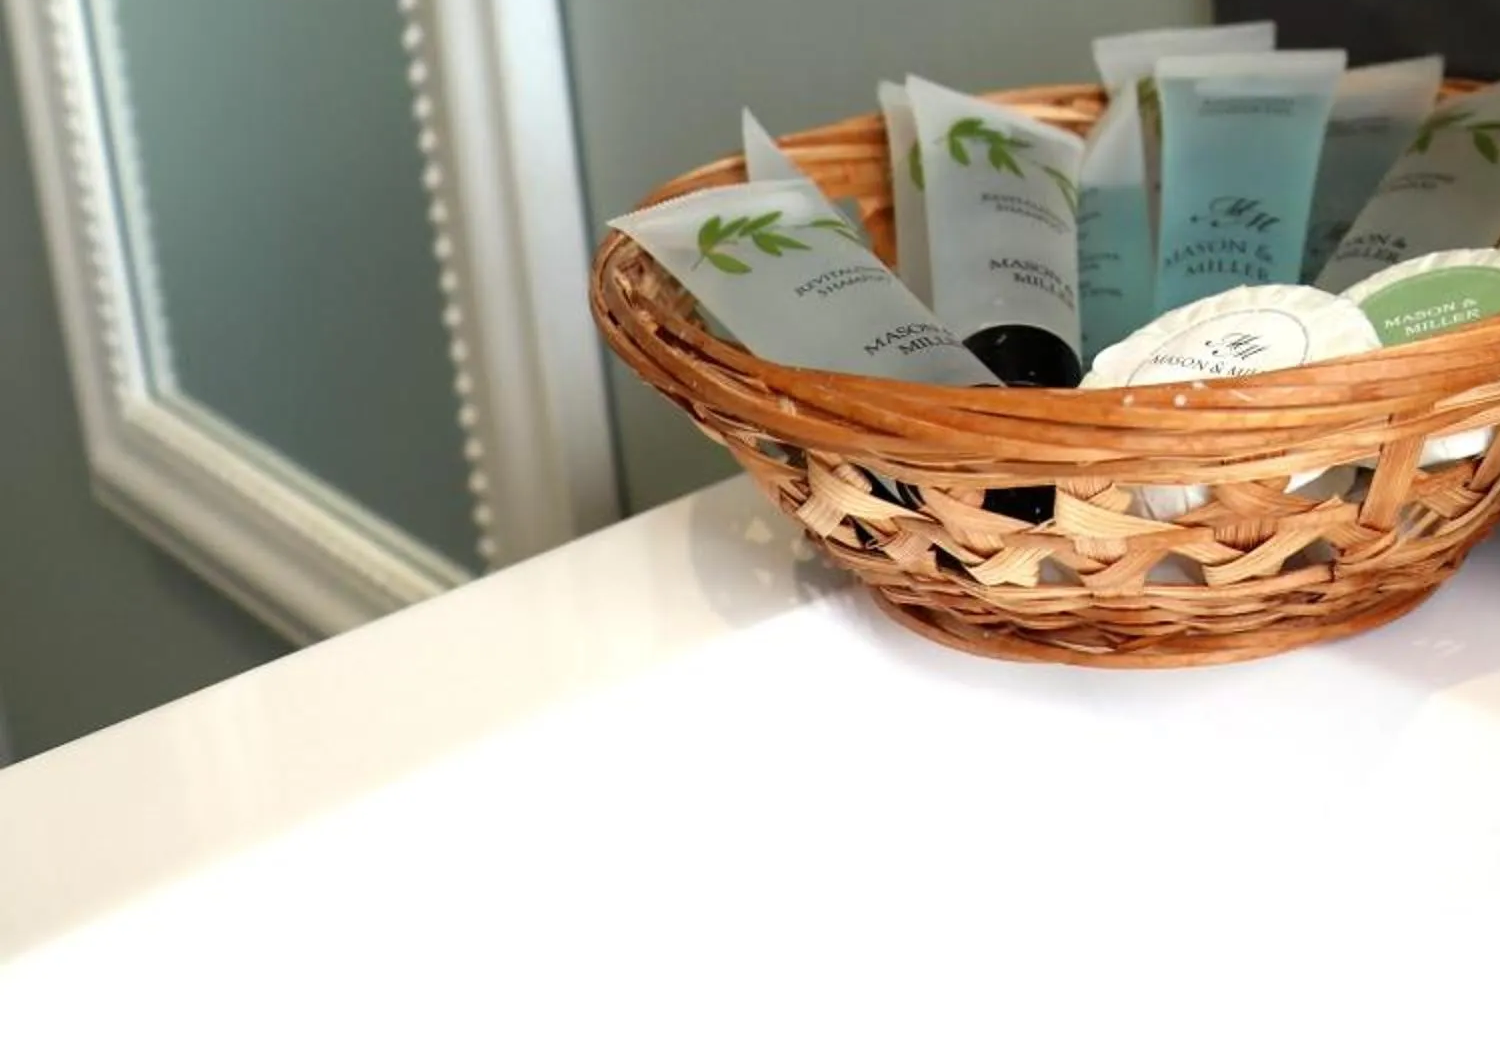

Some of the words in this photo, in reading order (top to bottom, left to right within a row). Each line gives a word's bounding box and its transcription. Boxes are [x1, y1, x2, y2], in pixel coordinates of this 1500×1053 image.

[1013, 272, 1076, 310] MILL
[1384, 300, 1456, 329] MASON
[1404, 307, 1481, 338] MILLER
[898, 335, 962, 356] MILL
[1151, 354, 1209, 371] MASON
